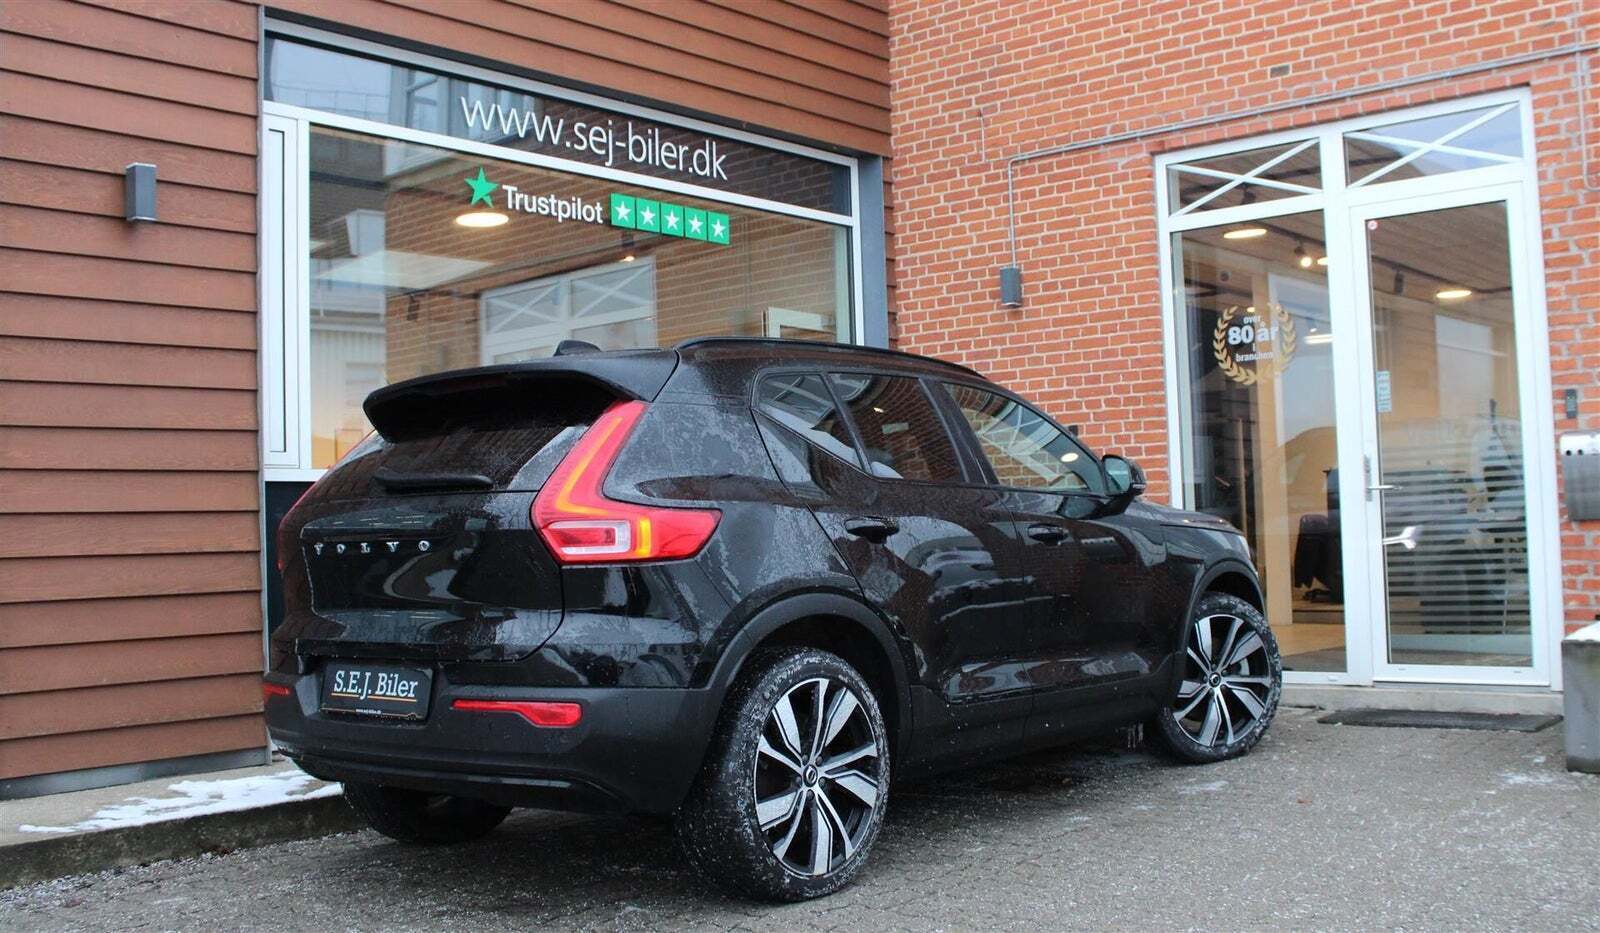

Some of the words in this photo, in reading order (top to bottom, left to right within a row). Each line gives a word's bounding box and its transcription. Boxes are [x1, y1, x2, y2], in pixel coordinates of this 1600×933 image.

[460, 96, 728, 181] www.sej-biler.dk
[502, 184, 604, 225] Trustpilot
[1227, 324, 1254, 345] 80
[1256, 321, 1279, 342] år
[313, 540, 430, 555] VOLVO
[333, 670, 372, 700] S.E.J.
[375, 672, 418, 698] Biler
